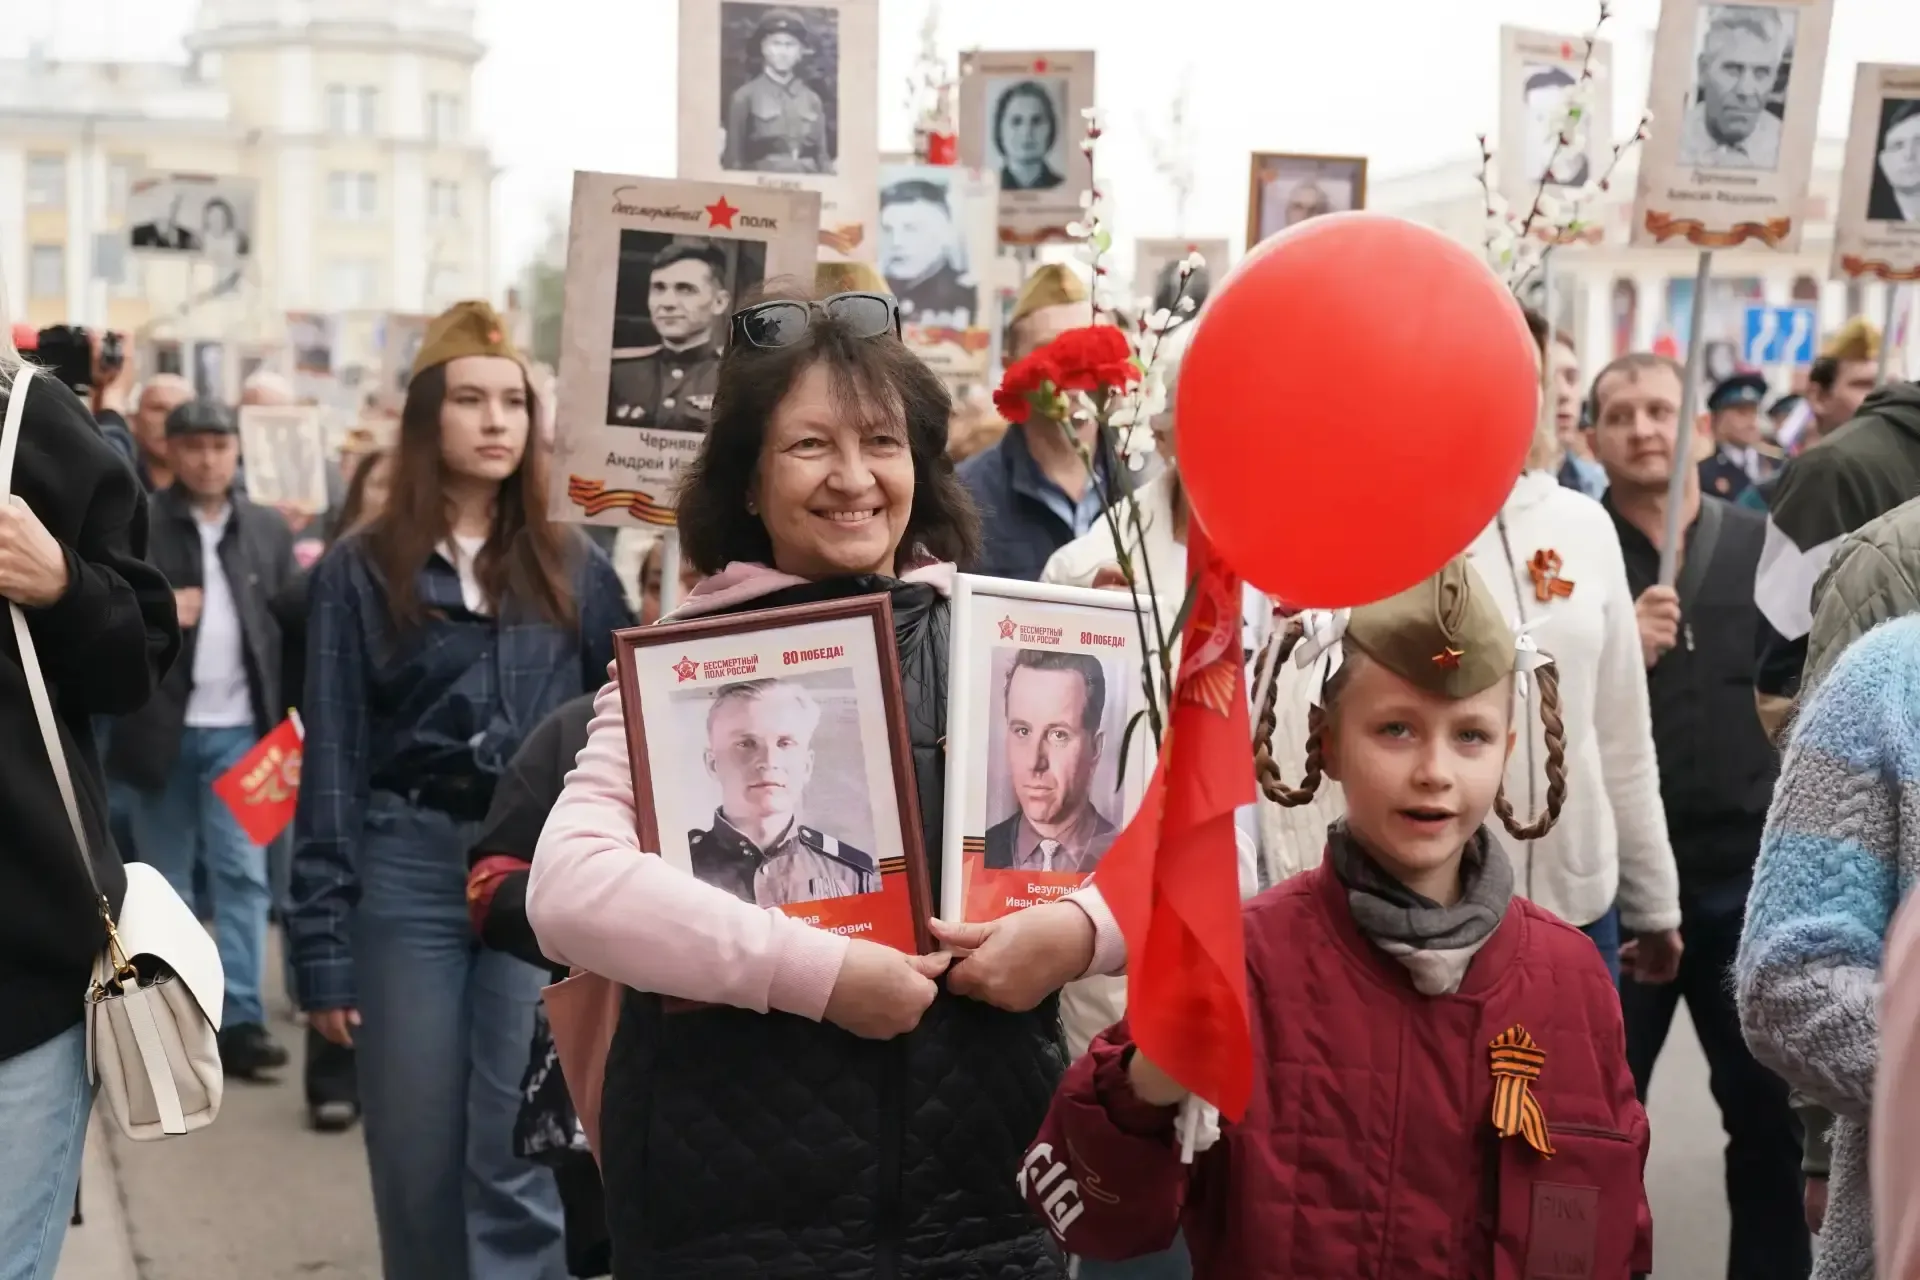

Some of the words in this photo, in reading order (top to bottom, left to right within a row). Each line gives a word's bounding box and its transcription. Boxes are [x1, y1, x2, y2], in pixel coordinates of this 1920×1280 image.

[605, 451, 664, 472] Андрей
[1019, 624, 1063, 638] БЕССМЕРТНЫЙ
[1019, 633, 1036, 644] ПОЛК
[1036, 635, 1060, 646] РОССИИ
[1080, 631, 1092, 645] 80
[1093, 635, 1126, 649] ПОБЕДА!
[703, 653, 759, 671] БЕССМЕРТНЫЙ
[782, 650, 799, 666] 80
[800, 645, 845, 663] ПОБЕДА!
[704, 668, 726, 680] ПОЛК
[726, 665, 757, 678] РОССИИ
[1027, 883, 1079, 897] Безуглый
[1005, 896, 1033, 908] Иван
